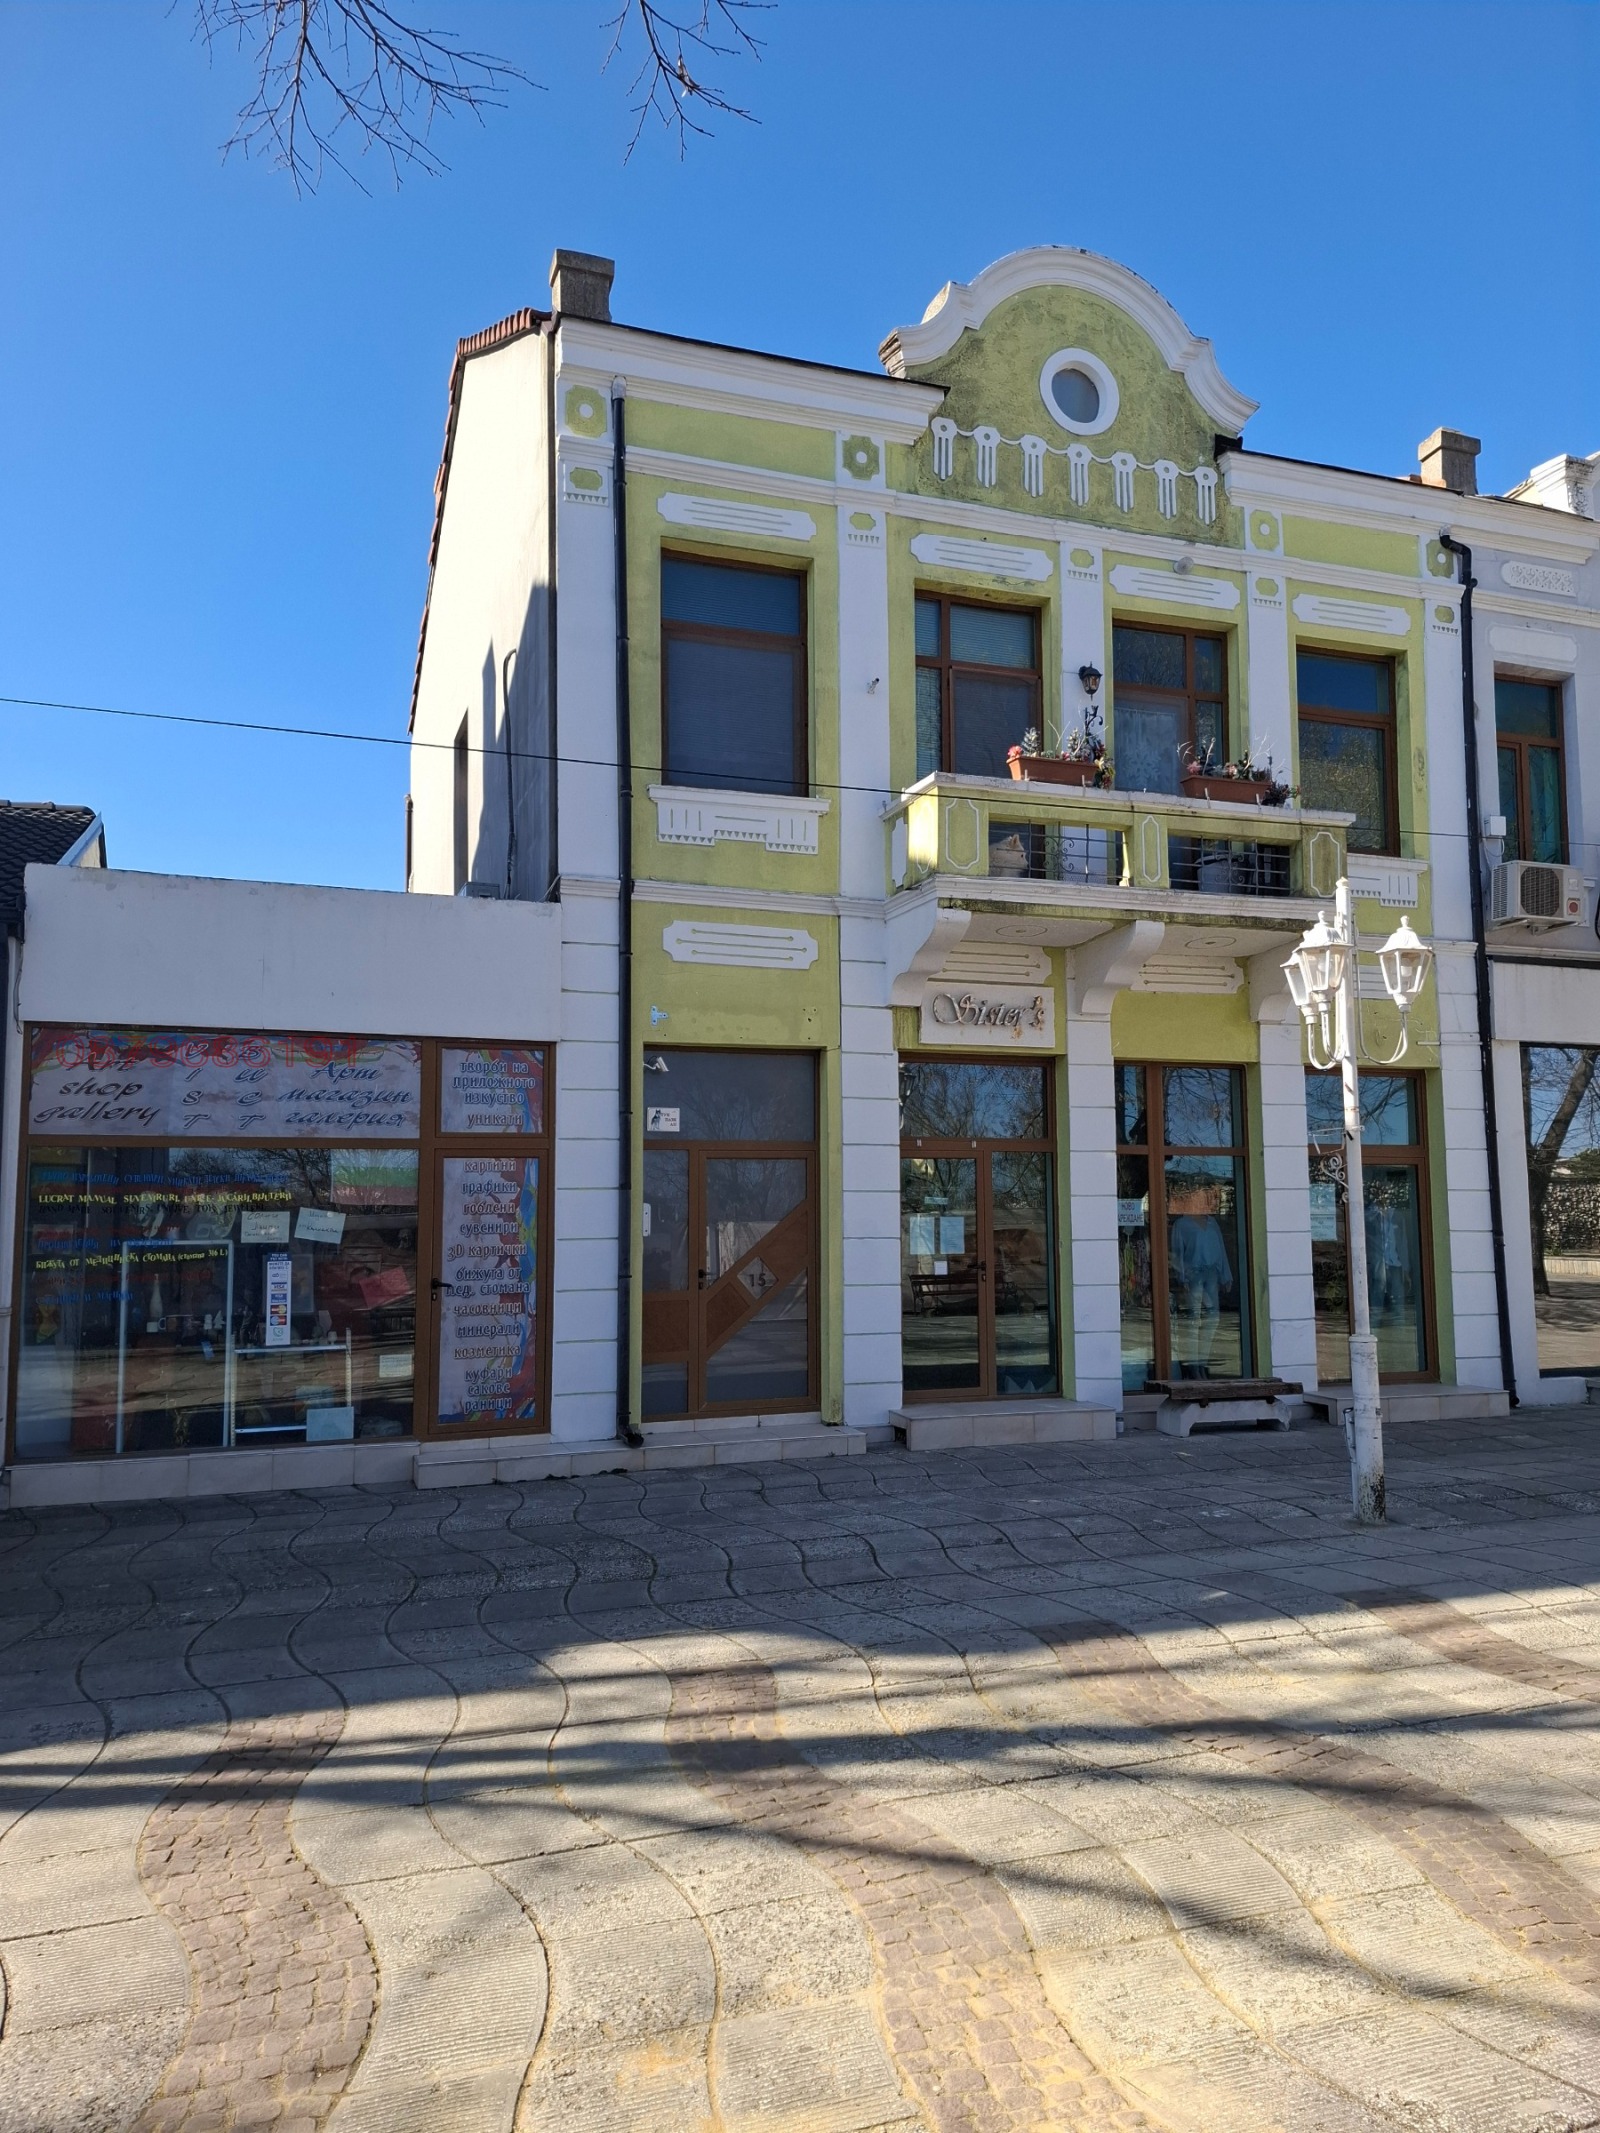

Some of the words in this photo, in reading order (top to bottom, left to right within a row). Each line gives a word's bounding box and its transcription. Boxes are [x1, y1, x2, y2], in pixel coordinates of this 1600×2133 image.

[933, 993, 1044, 1026] Sister's
[55, 1034, 358, 1069] 0879686191
[65, 1051, 140, 1072] Art
[460, 1059, 508, 1075] творби
[512, 1062, 529, 1074] на
[310, 1061, 382, 1085] Арт
[59, 1076, 143, 1101] shop
[452, 1076, 536, 1092] приложното
[278, 1087, 412, 1109] магазин
[464, 1092, 525, 1108] изкуство
[33, 1101, 161, 1127] gallery
[285, 1111, 406, 1130] галерия
[466, 1113, 523, 1129] уникати
[464, 1160, 517, 1175] картини
[462, 1180, 518, 1197] графики
[38, 1193, 74, 1204] LUCRAT
[78, 1194, 117, 1205] MANUAL
[463, 1200, 516, 1215] гоблени
[460, 1222, 518, 1238] сувенири
[69, 1258, 80, 1267] ОТ
[142, 1252, 176, 1263] СТОМАНА
[447, 1243, 465, 1261] 3D
[468, 1244, 528, 1260] картички
[456, 1266, 504, 1283] бижута
[508, 1267, 523, 1280] от
[749, 1273, 766, 1287] 15
[480, 1282, 531, 1295] стомана
[454, 1302, 522, 1317] часовници
[457, 1322, 521, 1339] минерали
[454, 1345, 521, 1360] козметика
[465, 1366, 513, 1384] куфари
[467, 1382, 511, 1397] сакове
[464, 1398, 512, 1415] раници
